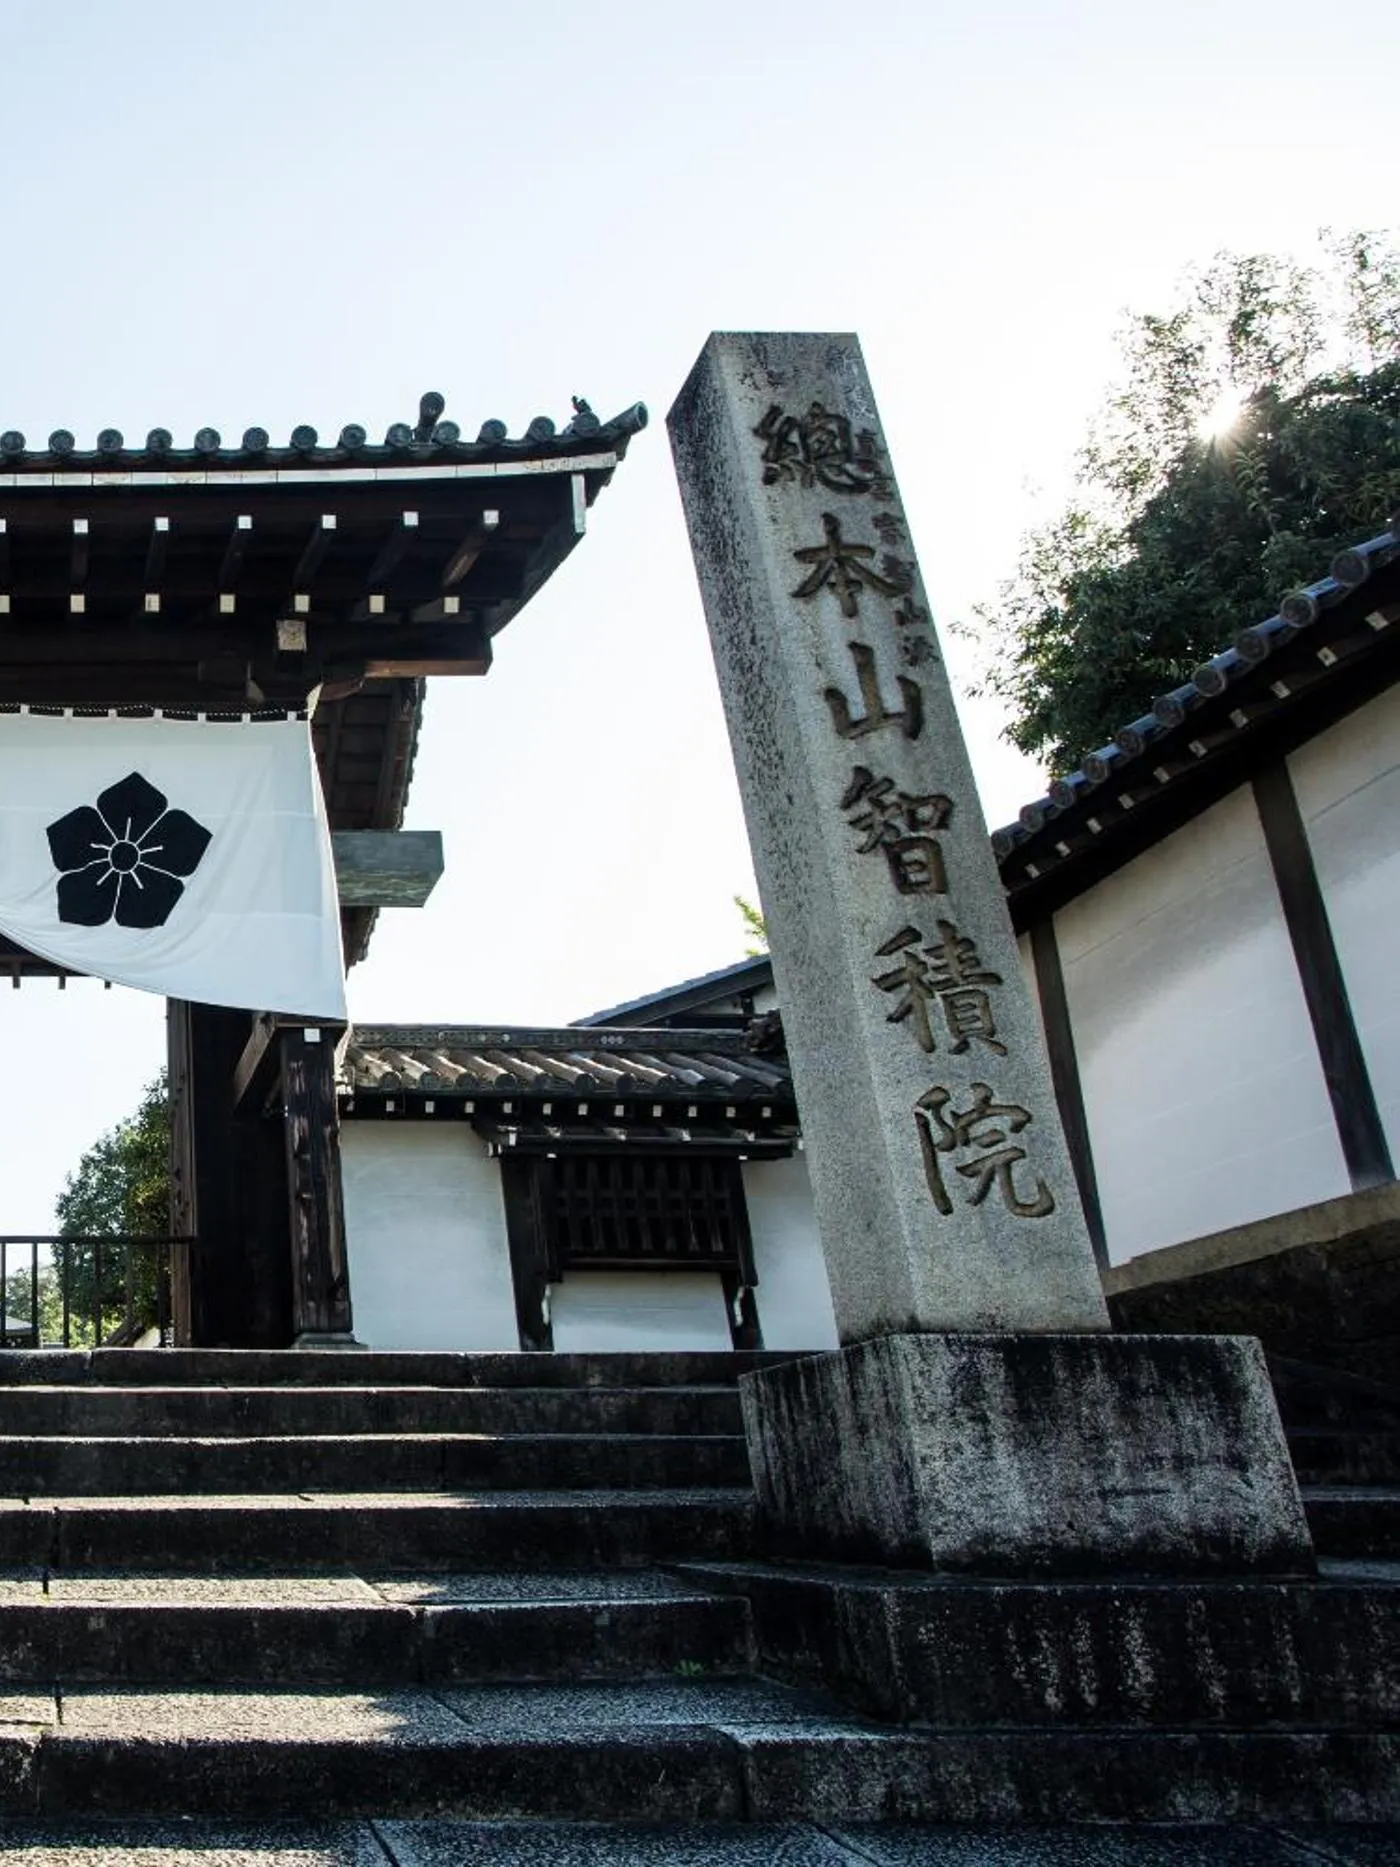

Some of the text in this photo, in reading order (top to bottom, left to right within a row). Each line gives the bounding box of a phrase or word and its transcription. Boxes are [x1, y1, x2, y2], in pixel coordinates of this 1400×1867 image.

[753, 402, 1055, 1218] 總本山智積院
